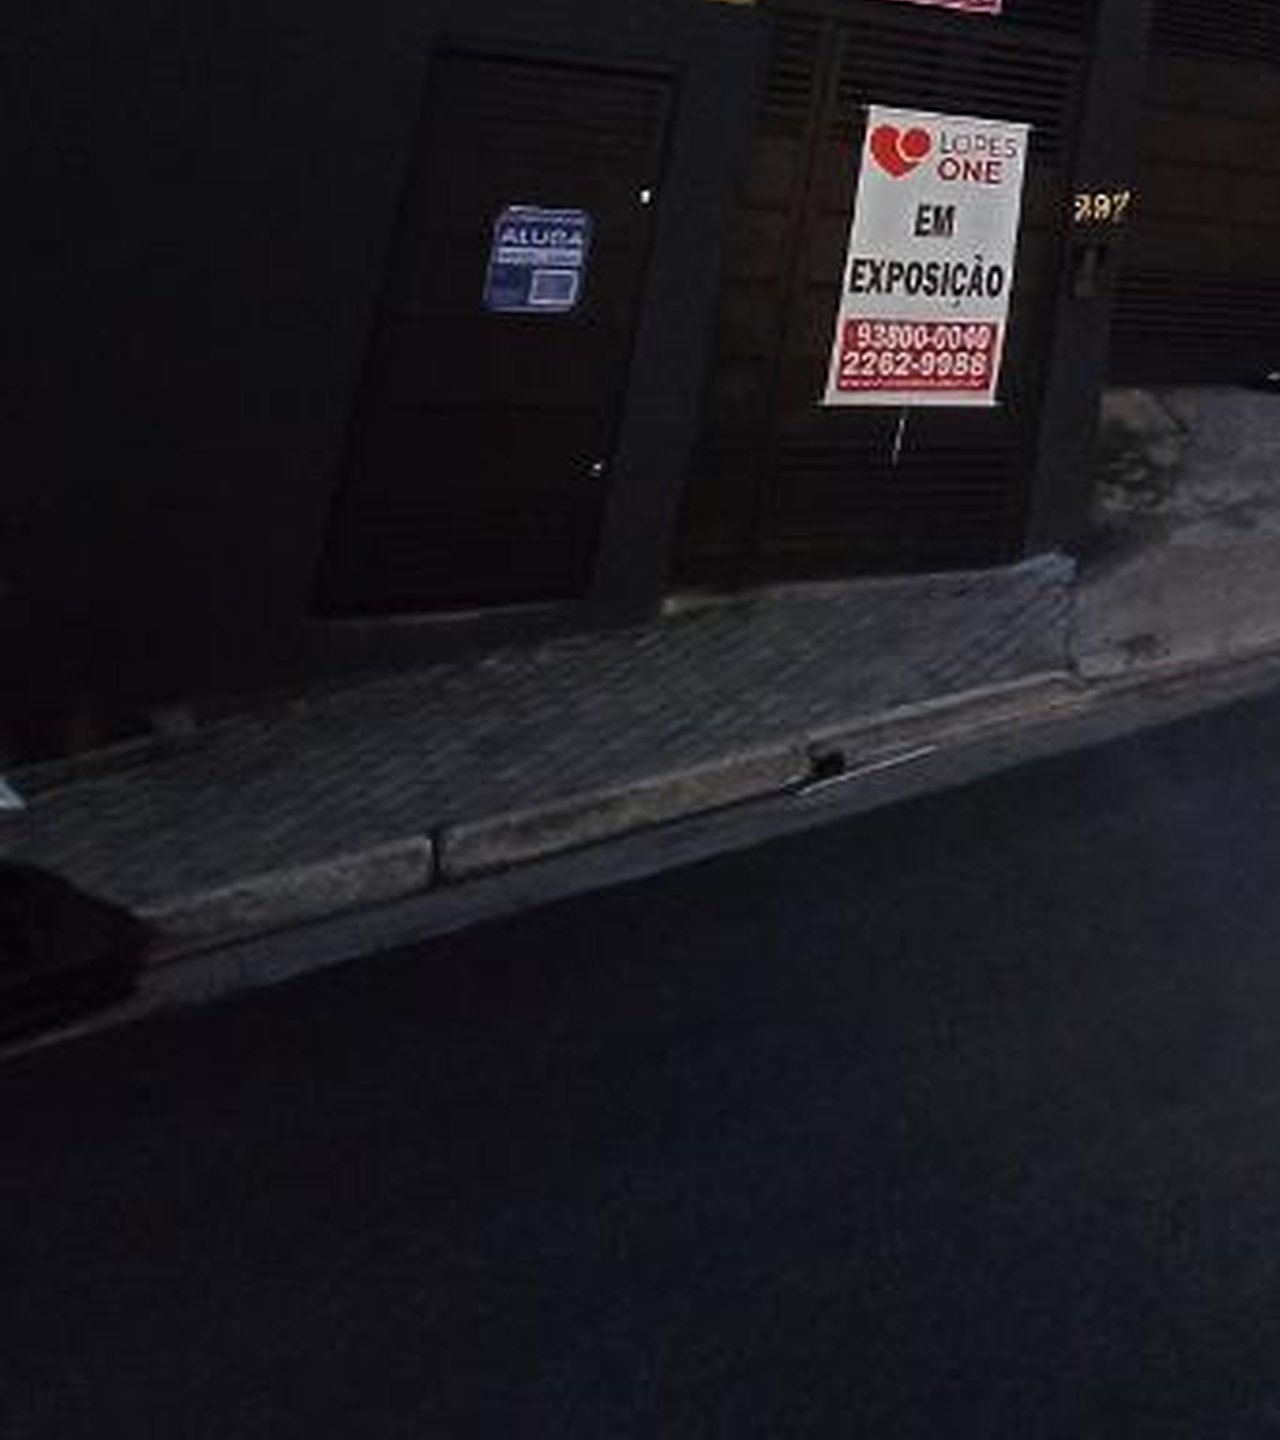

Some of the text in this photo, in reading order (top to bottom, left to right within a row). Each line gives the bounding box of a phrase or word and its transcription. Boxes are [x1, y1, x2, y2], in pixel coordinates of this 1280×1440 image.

[939, 130, 1019, 159] LOPES
[937, 157, 1003, 185] ONE
[913, 202, 956, 238] EM
[849, 254, 1005, 309] EXPOSIÇÃO
[841, 350, 988, 377] 2262-9988
